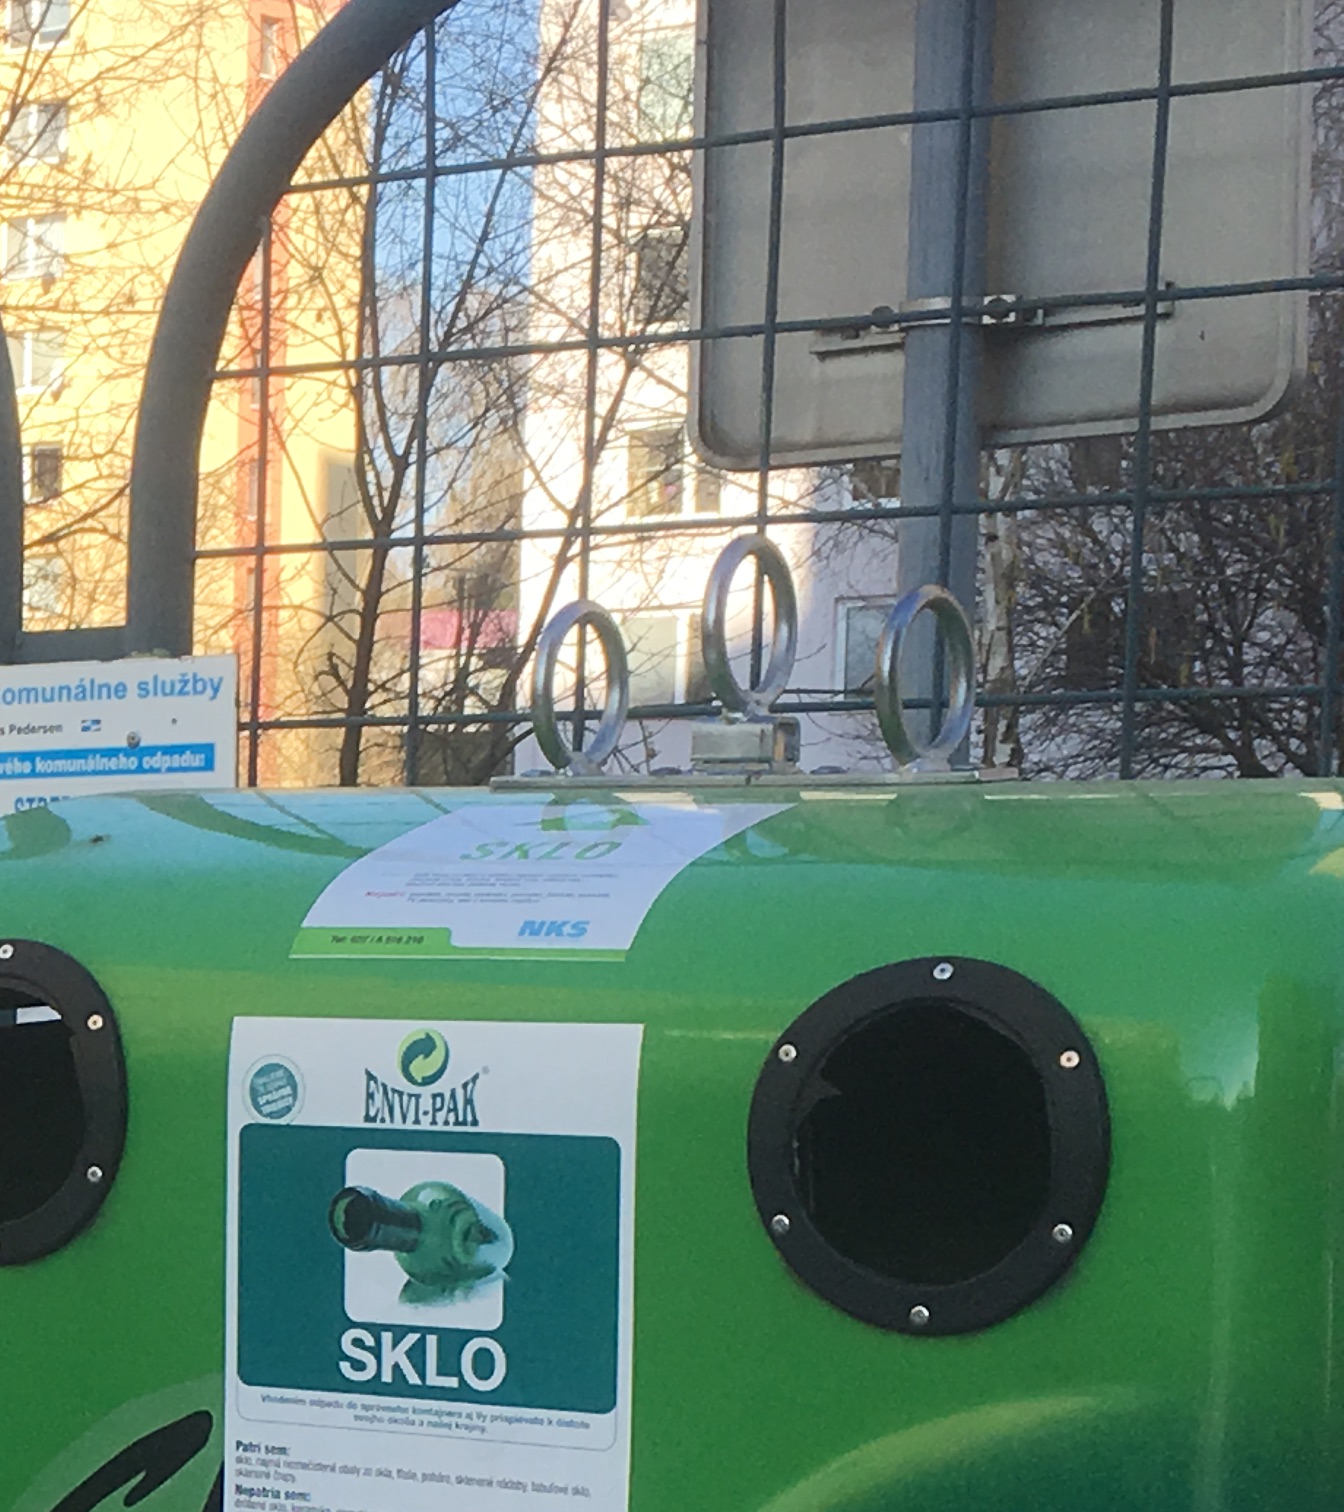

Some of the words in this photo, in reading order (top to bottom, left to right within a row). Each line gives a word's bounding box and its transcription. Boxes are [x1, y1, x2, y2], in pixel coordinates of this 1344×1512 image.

[136, 672, 224, 701] služby
[8, 723, 63, 736] Pedersen
[35, 752, 138, 774] komunálneho
[142, 750, 206, 772] odpadu:
[459, 841, 624, 861] SKLO
[517, 919, 591, 938] NKS
[363, 1068, 481, 1127] ENVI-PAK
[339, 1328, 507, 1392] SKLO
